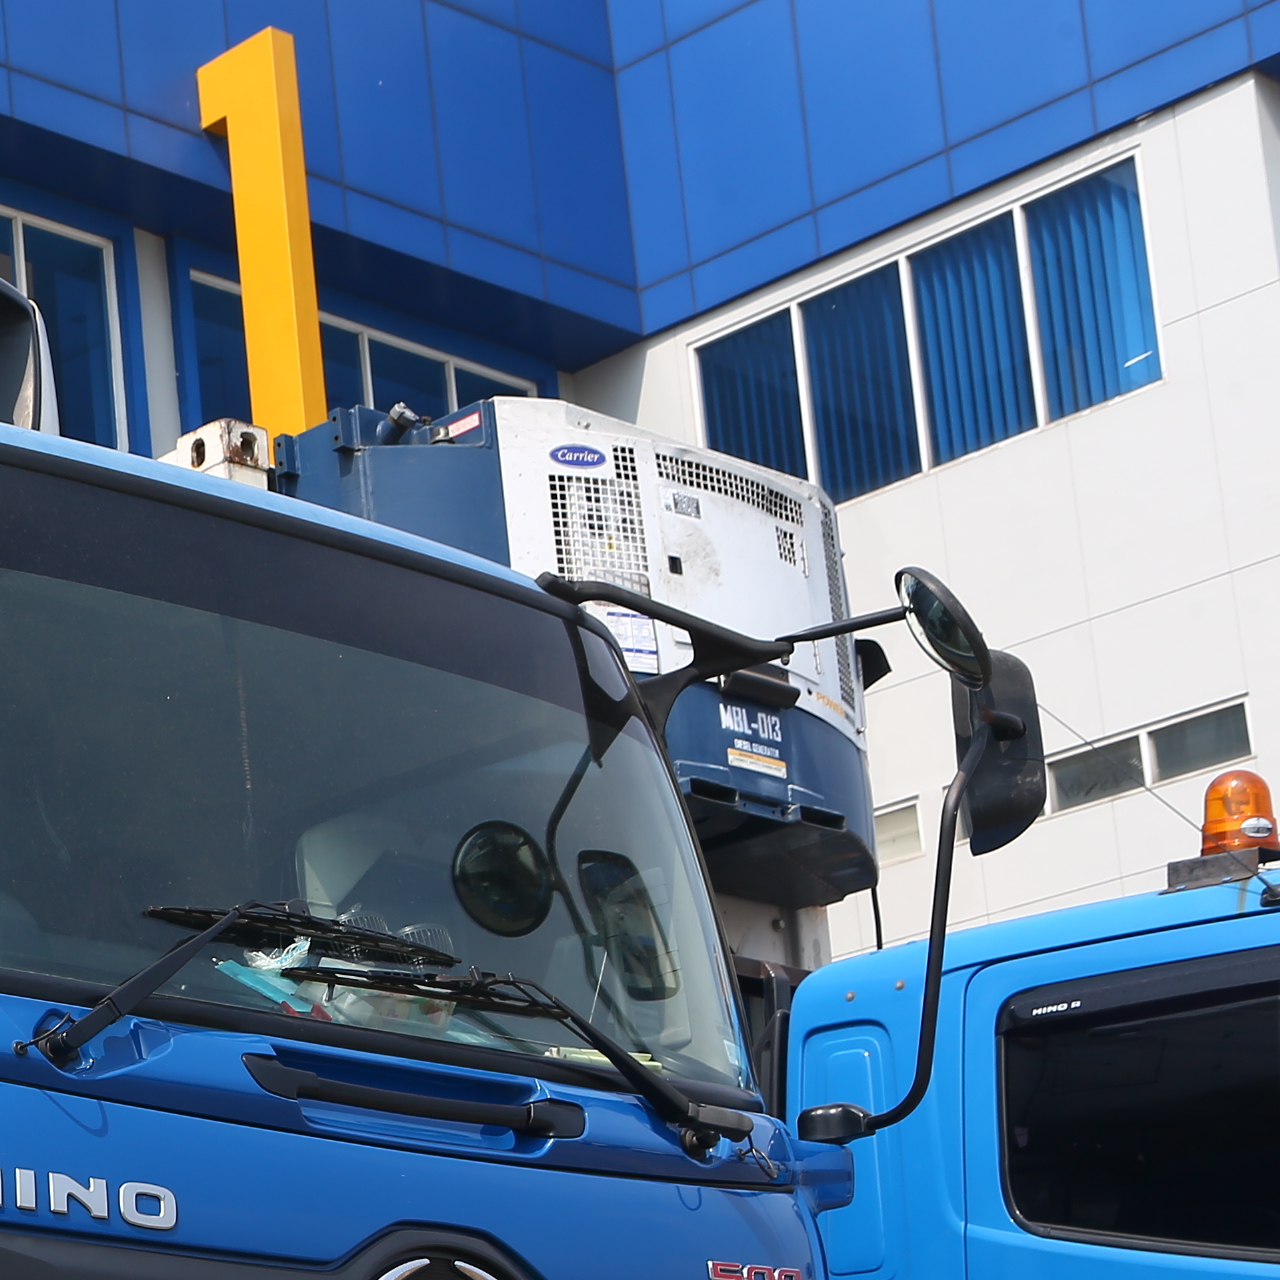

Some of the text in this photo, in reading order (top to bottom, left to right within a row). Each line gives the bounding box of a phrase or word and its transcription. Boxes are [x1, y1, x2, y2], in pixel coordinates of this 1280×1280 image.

[557, 448, 600, 462] Carrier
[719, 703, 782, 742] MBL-013
[1032, 1002, 1068, 1016] HINO
